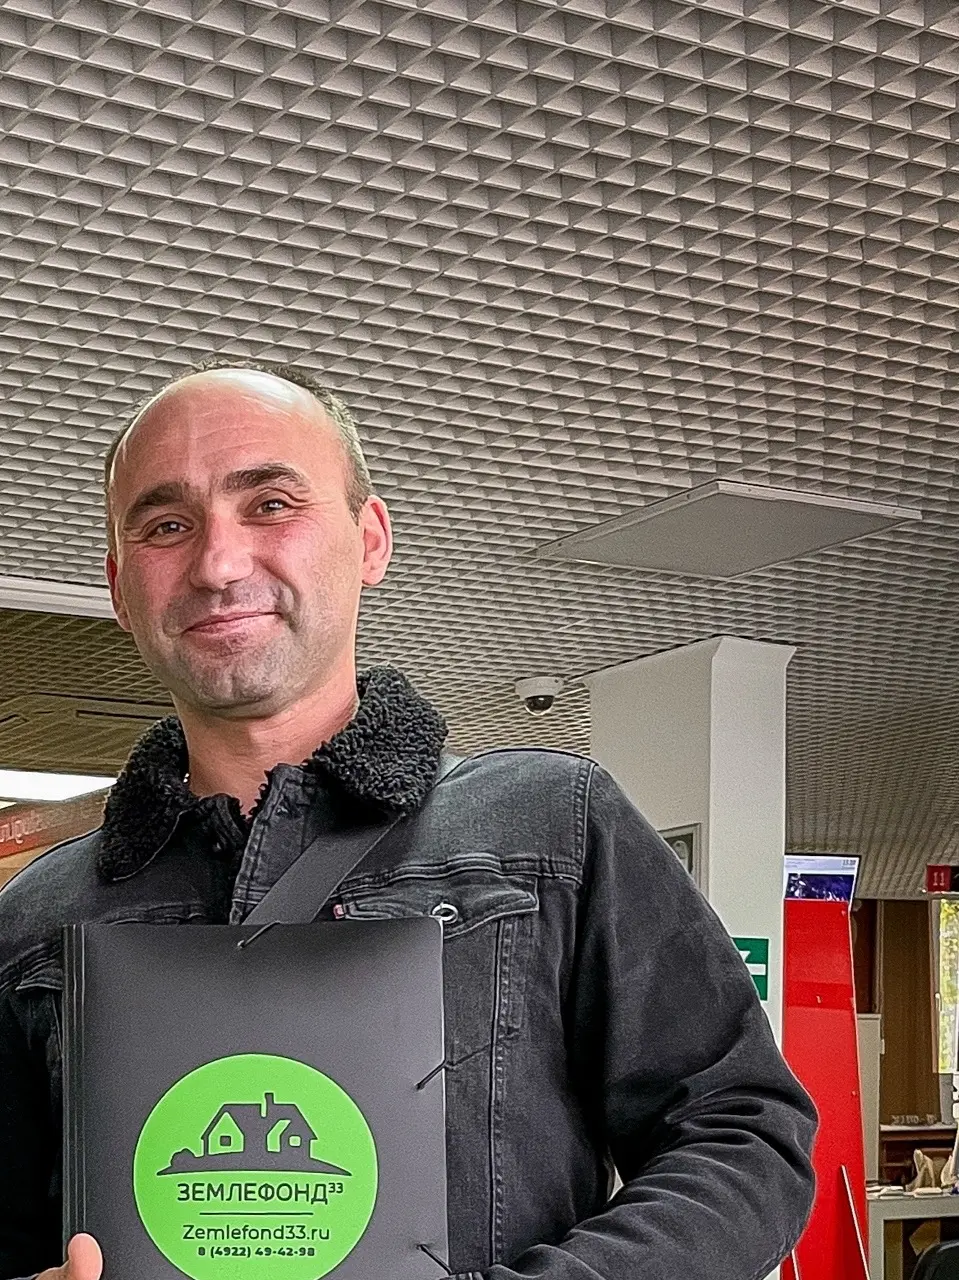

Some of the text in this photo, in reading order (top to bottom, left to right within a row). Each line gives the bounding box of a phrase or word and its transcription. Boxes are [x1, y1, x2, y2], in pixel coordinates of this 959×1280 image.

[182, 1224, 330, 1241] Zemlefond33.ru
[198, 1246, 315, 1258] 8 (4922) 49-42-98
